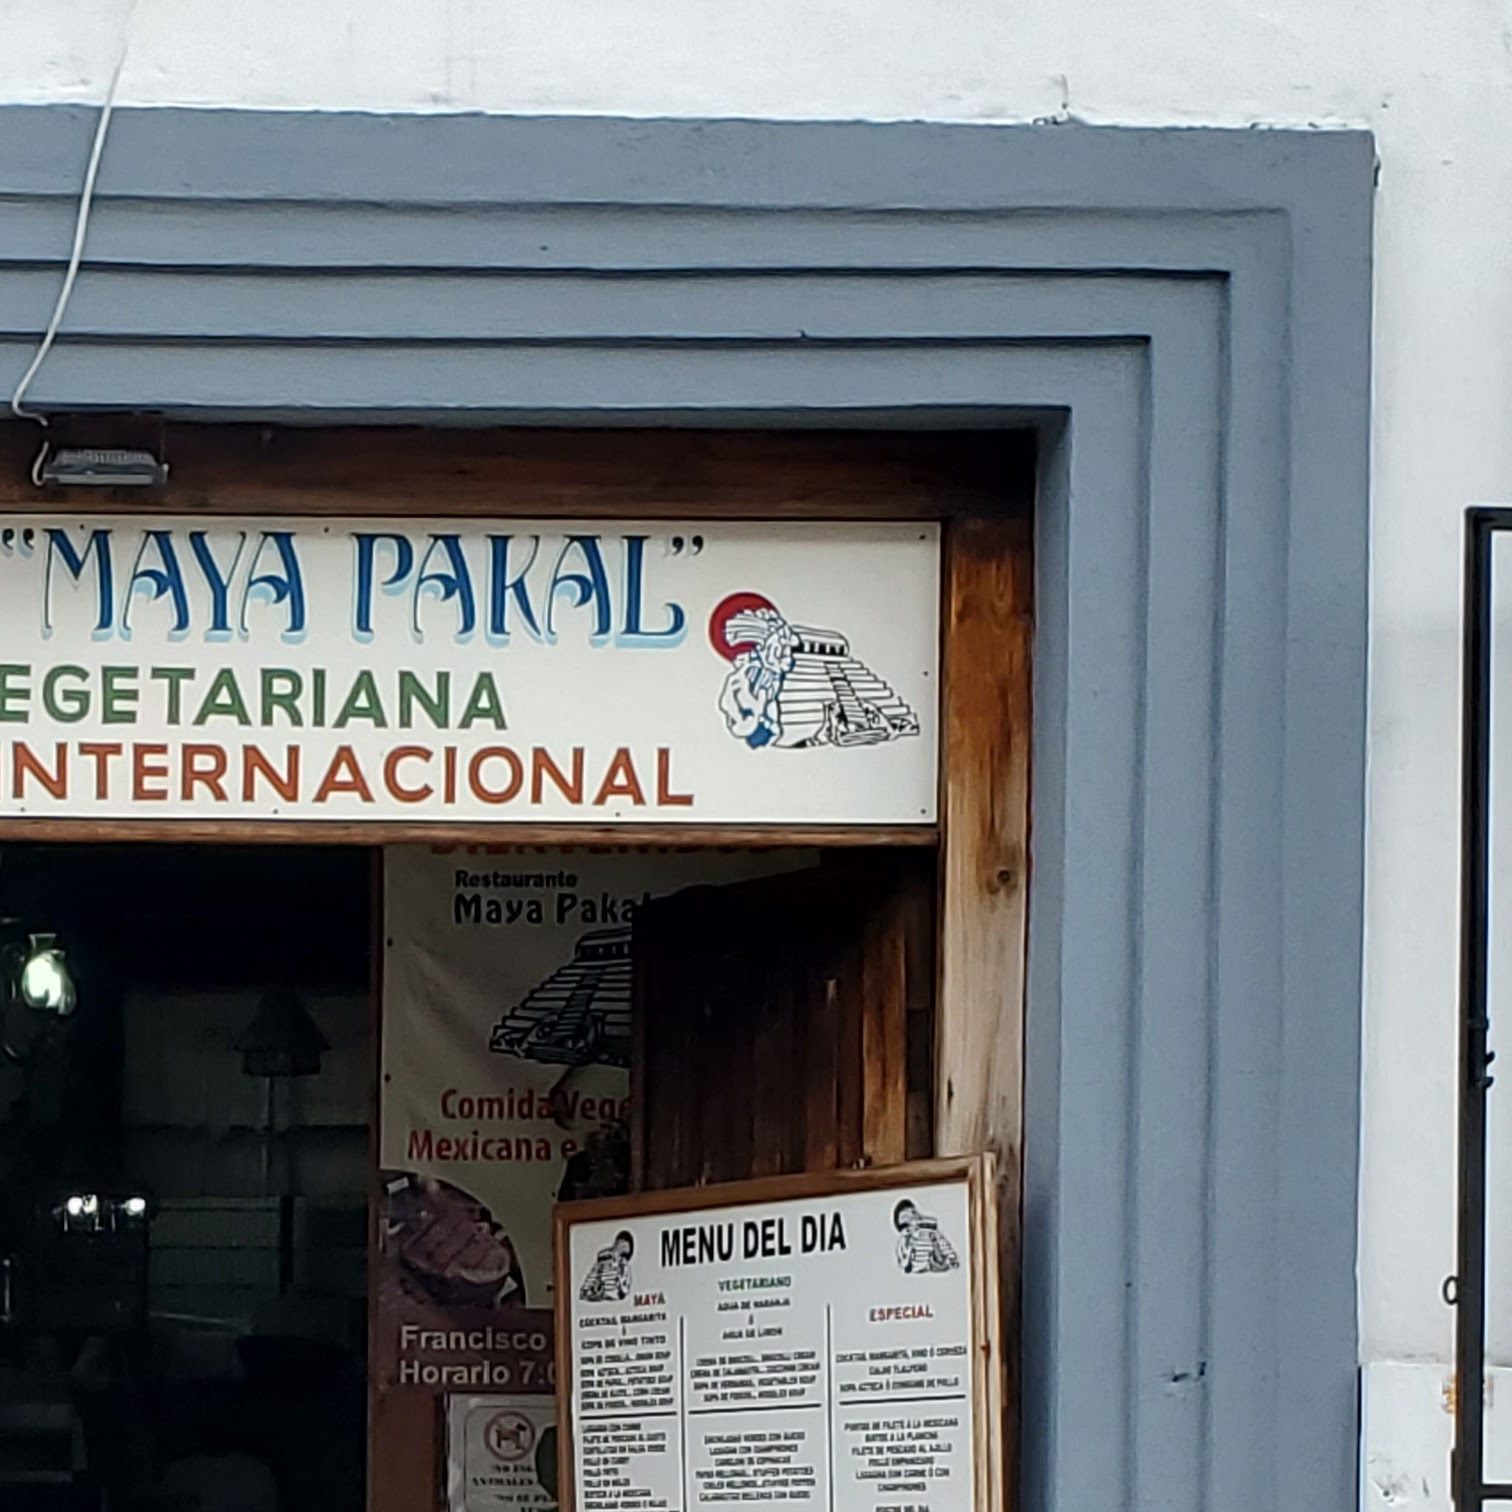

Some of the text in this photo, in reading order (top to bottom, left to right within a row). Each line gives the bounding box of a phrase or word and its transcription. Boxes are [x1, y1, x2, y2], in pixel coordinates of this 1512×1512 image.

[455, 893, 543, 924] Maya
[441, 1088, 552, 1120] Comida
[408, 1130, 551, 1160] Mexicana
[661, 1212, 847, 1268] MENU DEL DIA
[717, 1276, 791, 1292] VEGETARIANO
[633, 1291, 666, 1307] MAYA
[869, 1305, 934, 1321] ESPECIAL
[399, 1324, 547, 1351] Francisco
[399, 1359, 510, 1384] Horario
